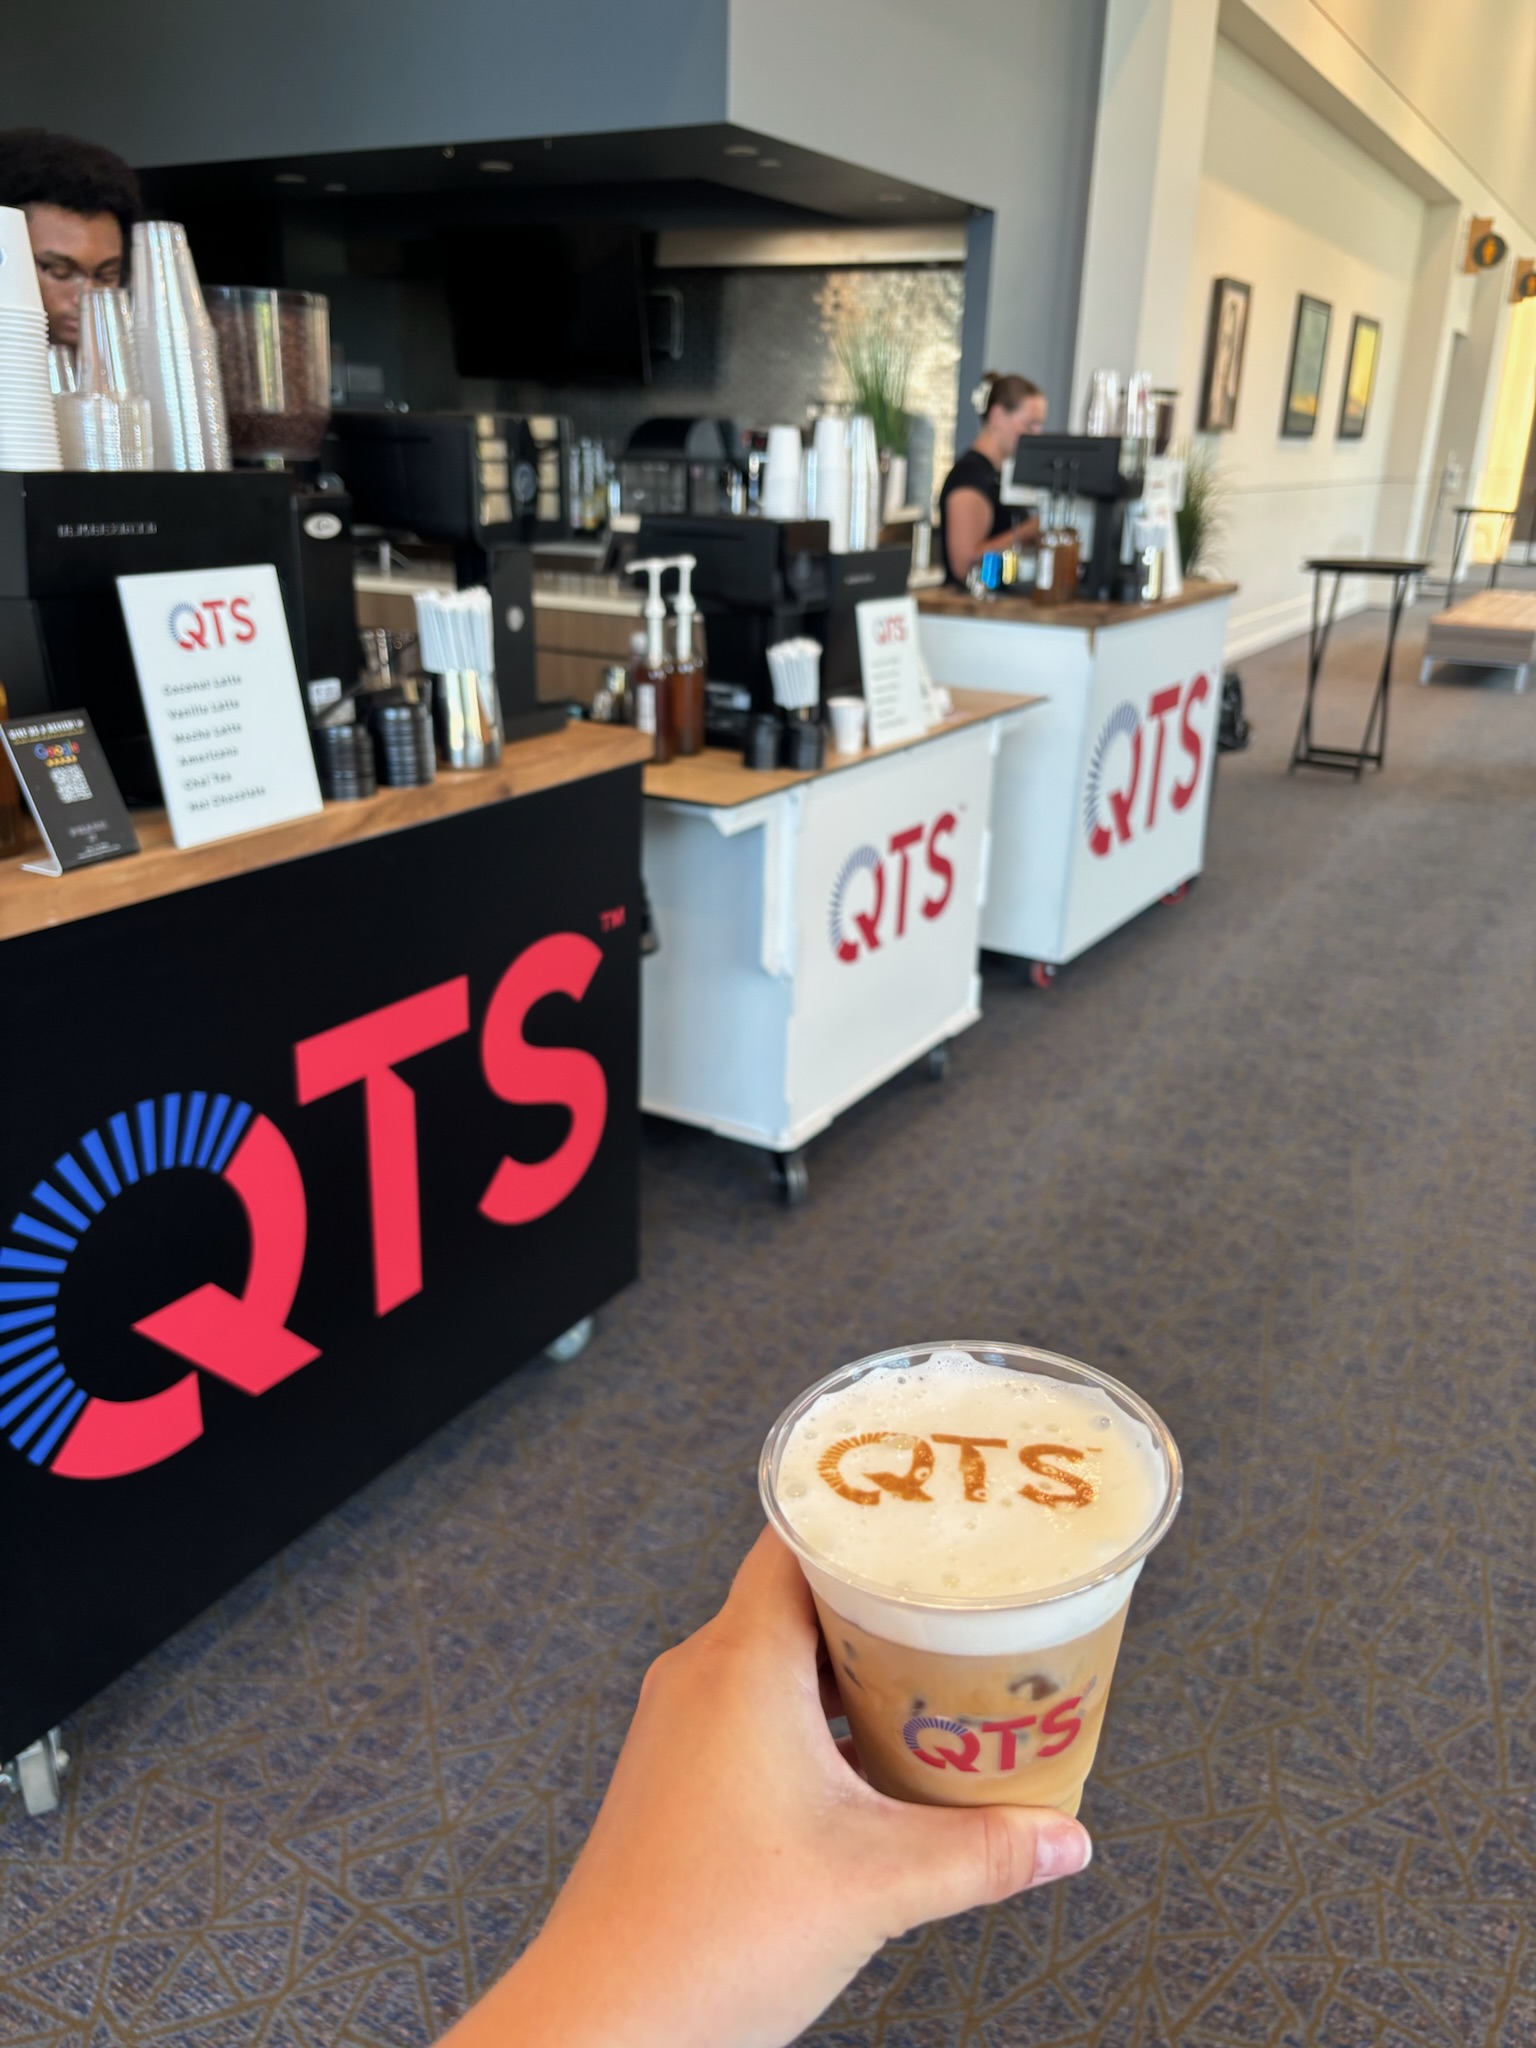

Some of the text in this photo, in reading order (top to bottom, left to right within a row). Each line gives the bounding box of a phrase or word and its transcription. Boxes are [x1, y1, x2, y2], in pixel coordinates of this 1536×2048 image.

[167, 598, 257, 652] QTS
[163, 675, 242, 697] Coconut Latte
[168, 703, 209, 719] Vanilla
[213, 722, 242, 738] Latte
[34, 738, 80, 760] Google
[178, 746, 239, 767] Americano
[1083, 674, 1209, 858] QTS
[212, 786, 266, 808] Chocolate
[828, 811, 957, 965] QTS
[0, 932, 608, 1479] QTS
[817, 1431, 1098, 1509] QTS
[903, 1696, 1083, 1773] QTS
